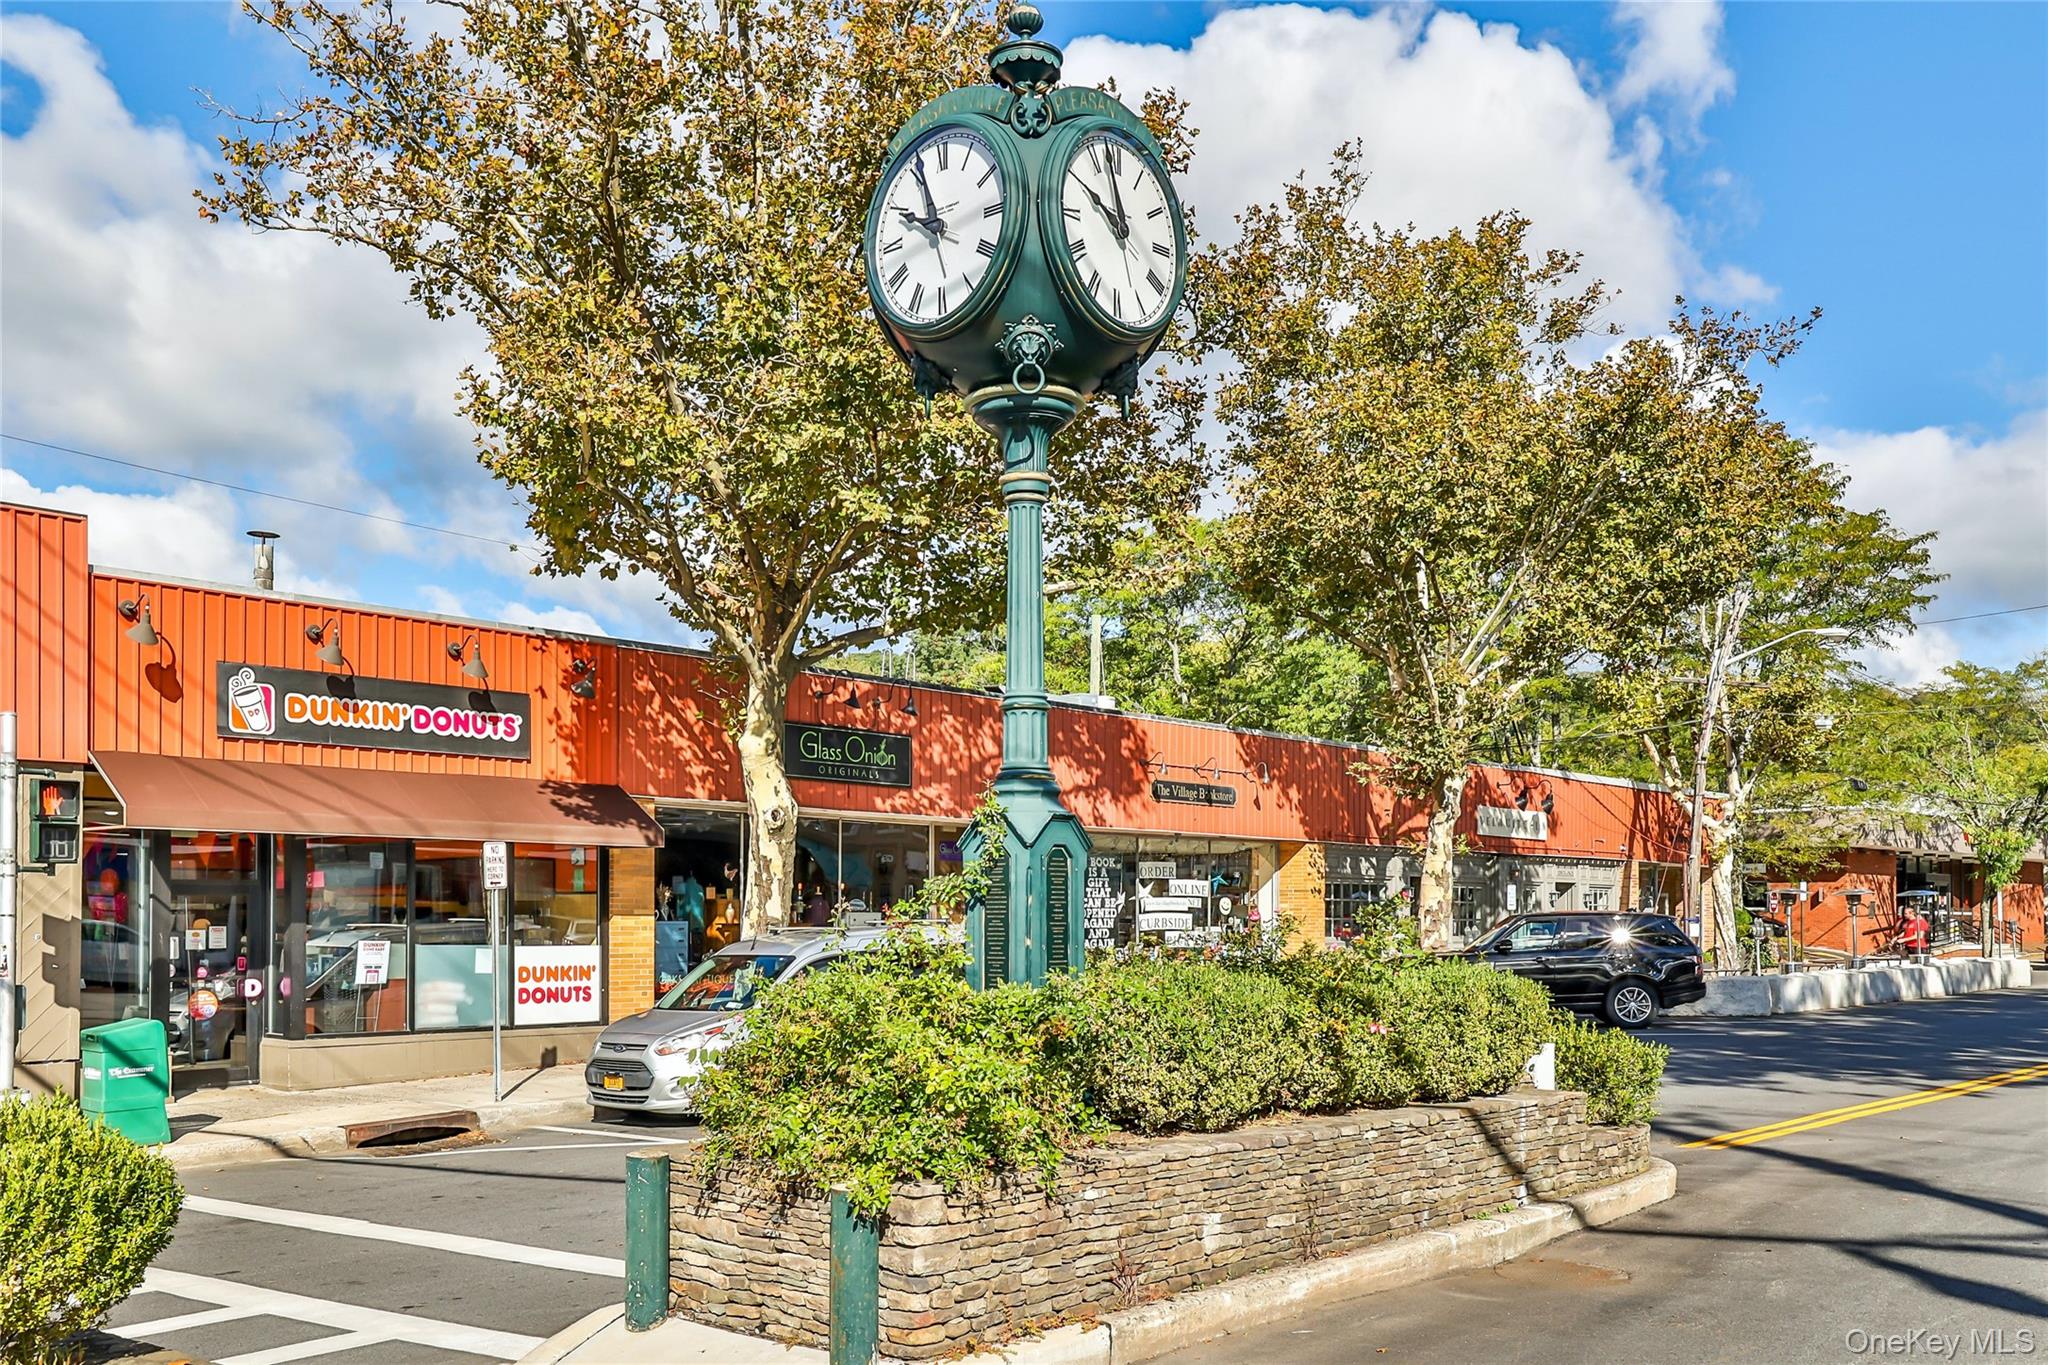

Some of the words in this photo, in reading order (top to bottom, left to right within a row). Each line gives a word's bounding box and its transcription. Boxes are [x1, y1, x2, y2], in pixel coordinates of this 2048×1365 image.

[287, 695, 410, 728] DUNKIN'
[413, 707, 519, 739] DONUTS
[800, 731, 842, 760] Glass
[845, 736, 896, 766] Onion
[818, 765, 879, 779] ORIGINALS
[1156, 783, 1170, 796] The
[1172, 784, 1198, 801] Village
[1199, 787, 1233, 802] Bkstore
[490, 845, 500, 854] NO
[1090, 857, 1116, 867] BOOK
[1088, 867, 1098, 877] IS
[1101, 868, 1108, 877] A
[1139, 866, 1175, 878] ORDER
[1087, 878, 1109, 887] GIFT
[1086, 887, 1111, 897] THAT
[1169, 883, 1208, 895] ONLINE
[1104, 898, 1117, 908] BE
[1084, 918, 1114, 928] AGAIN
[1139, 917, 1191, 929] CURBSIDE
[1088, 929, 1109, 938] AND
[1084, 938, 1115, 948] AGAIN
[518, 965, 596, 983] DUNKIN'
[518, 986, 592, 1004] DONUTS
